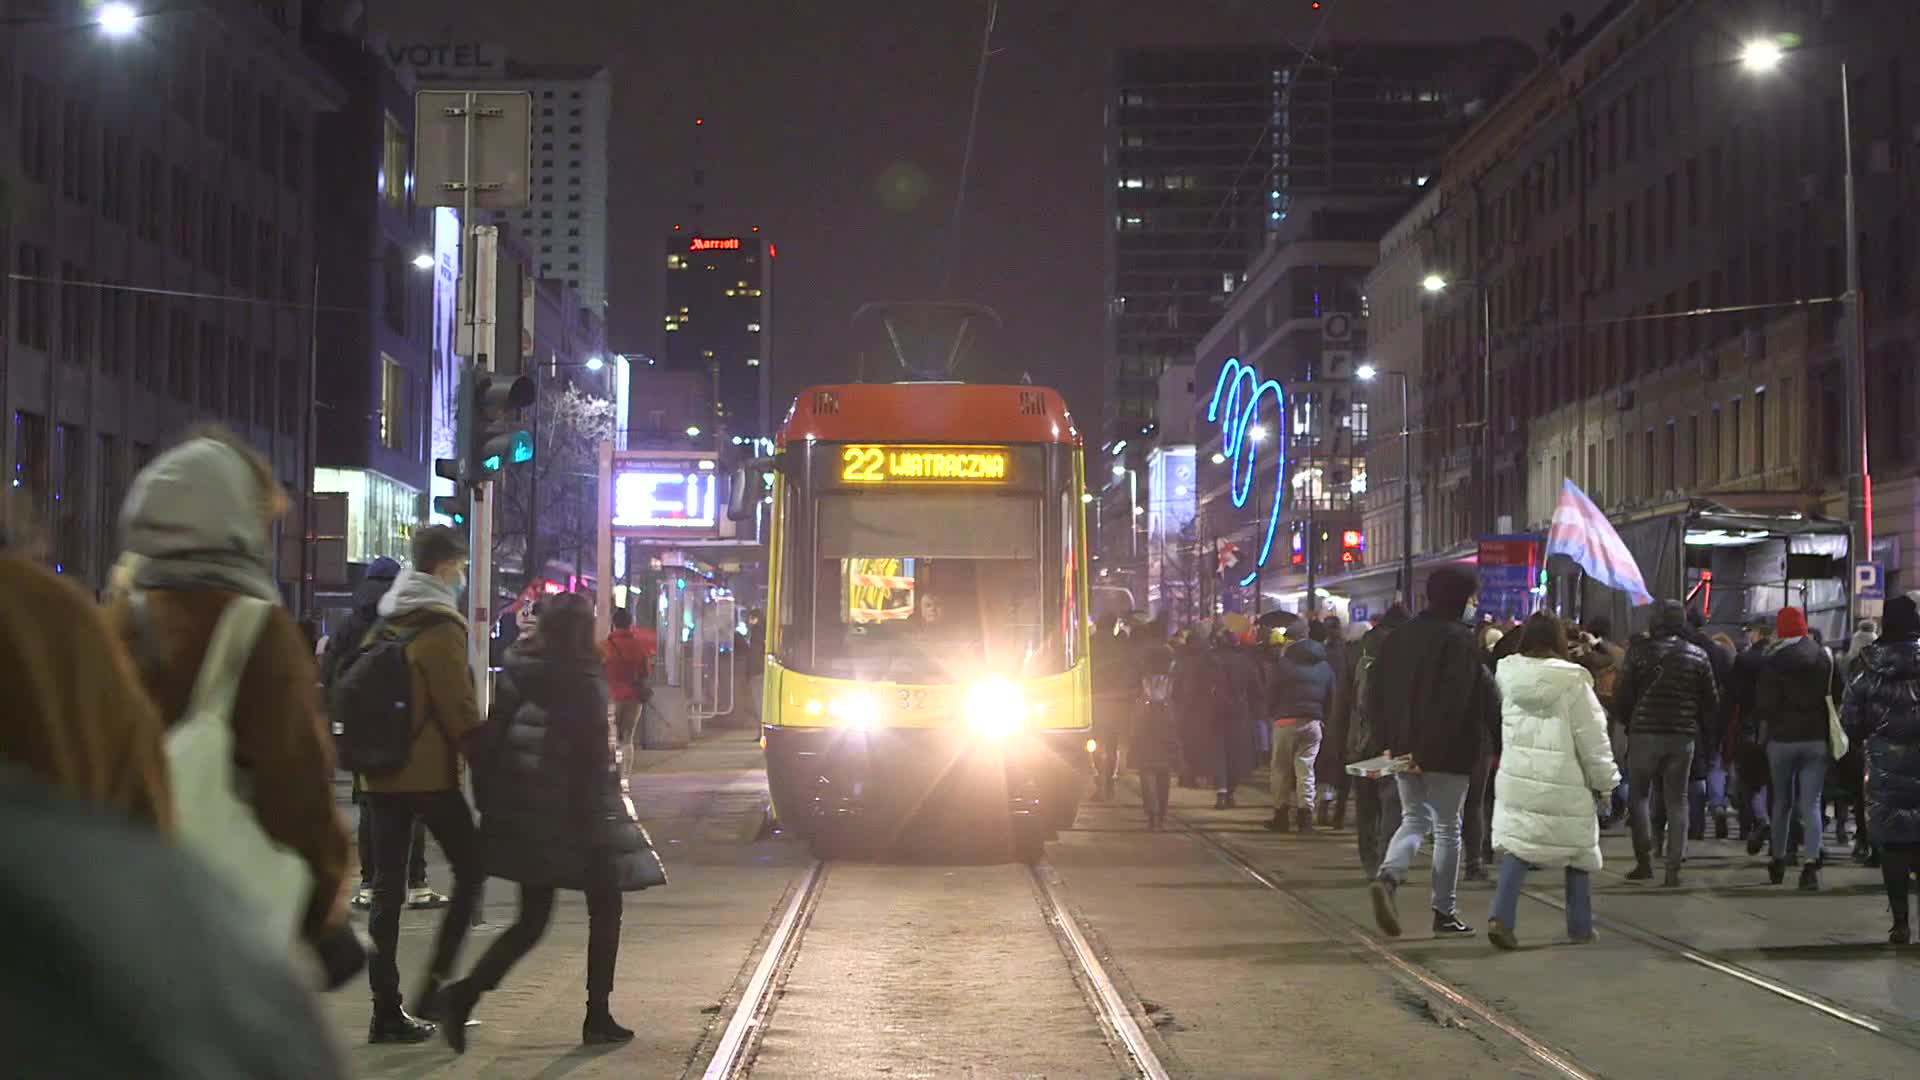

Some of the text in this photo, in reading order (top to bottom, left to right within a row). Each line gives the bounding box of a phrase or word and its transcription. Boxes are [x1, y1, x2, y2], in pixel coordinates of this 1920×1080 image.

[689, 238, 739, 250] Marriott
[843, 447, 1004, 481] 22 WIATRACZNA
[1855, 566, 1876, 595] P
